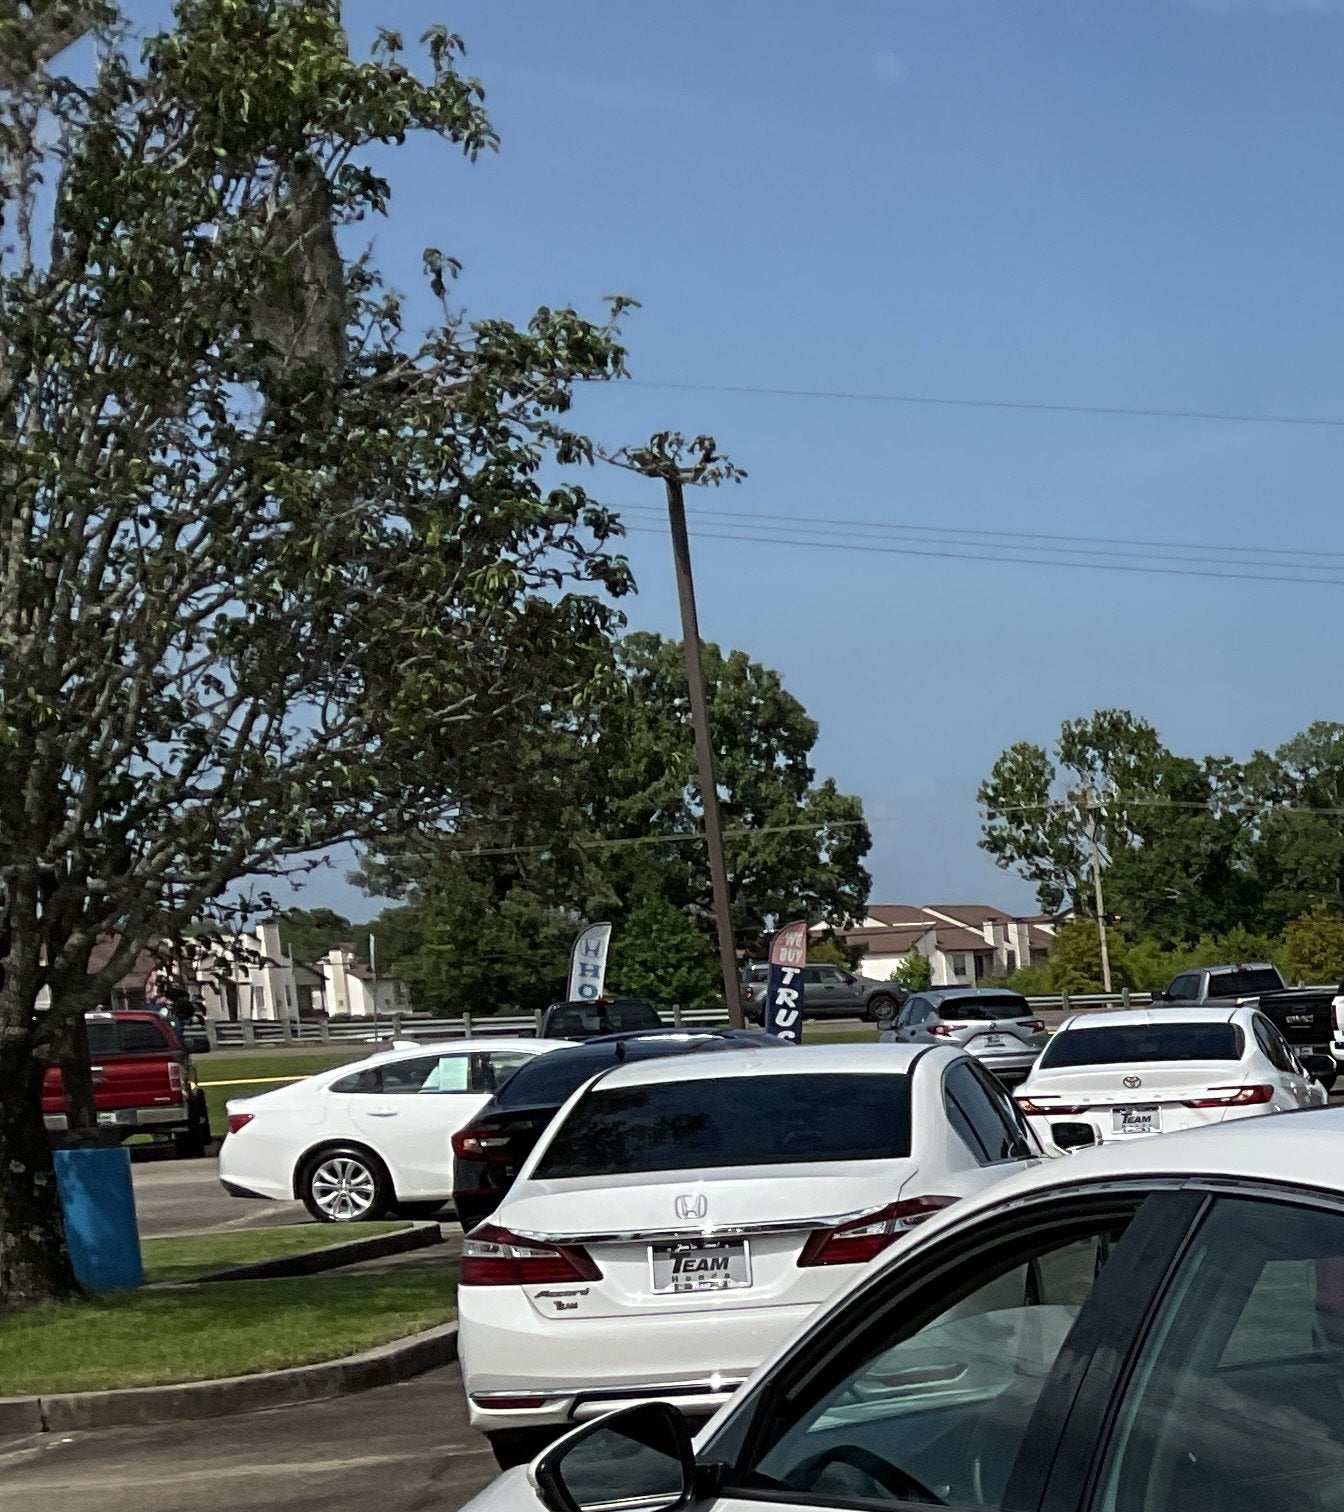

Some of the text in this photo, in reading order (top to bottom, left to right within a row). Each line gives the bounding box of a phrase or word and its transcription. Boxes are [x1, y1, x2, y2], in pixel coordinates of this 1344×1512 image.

[785, 932, 801, 946] WE
[780, 947, 801, 962] BUY
[1121, 1112, 1151, 1124] TEAM
[670, 1253, 730, 1274] TEAM
